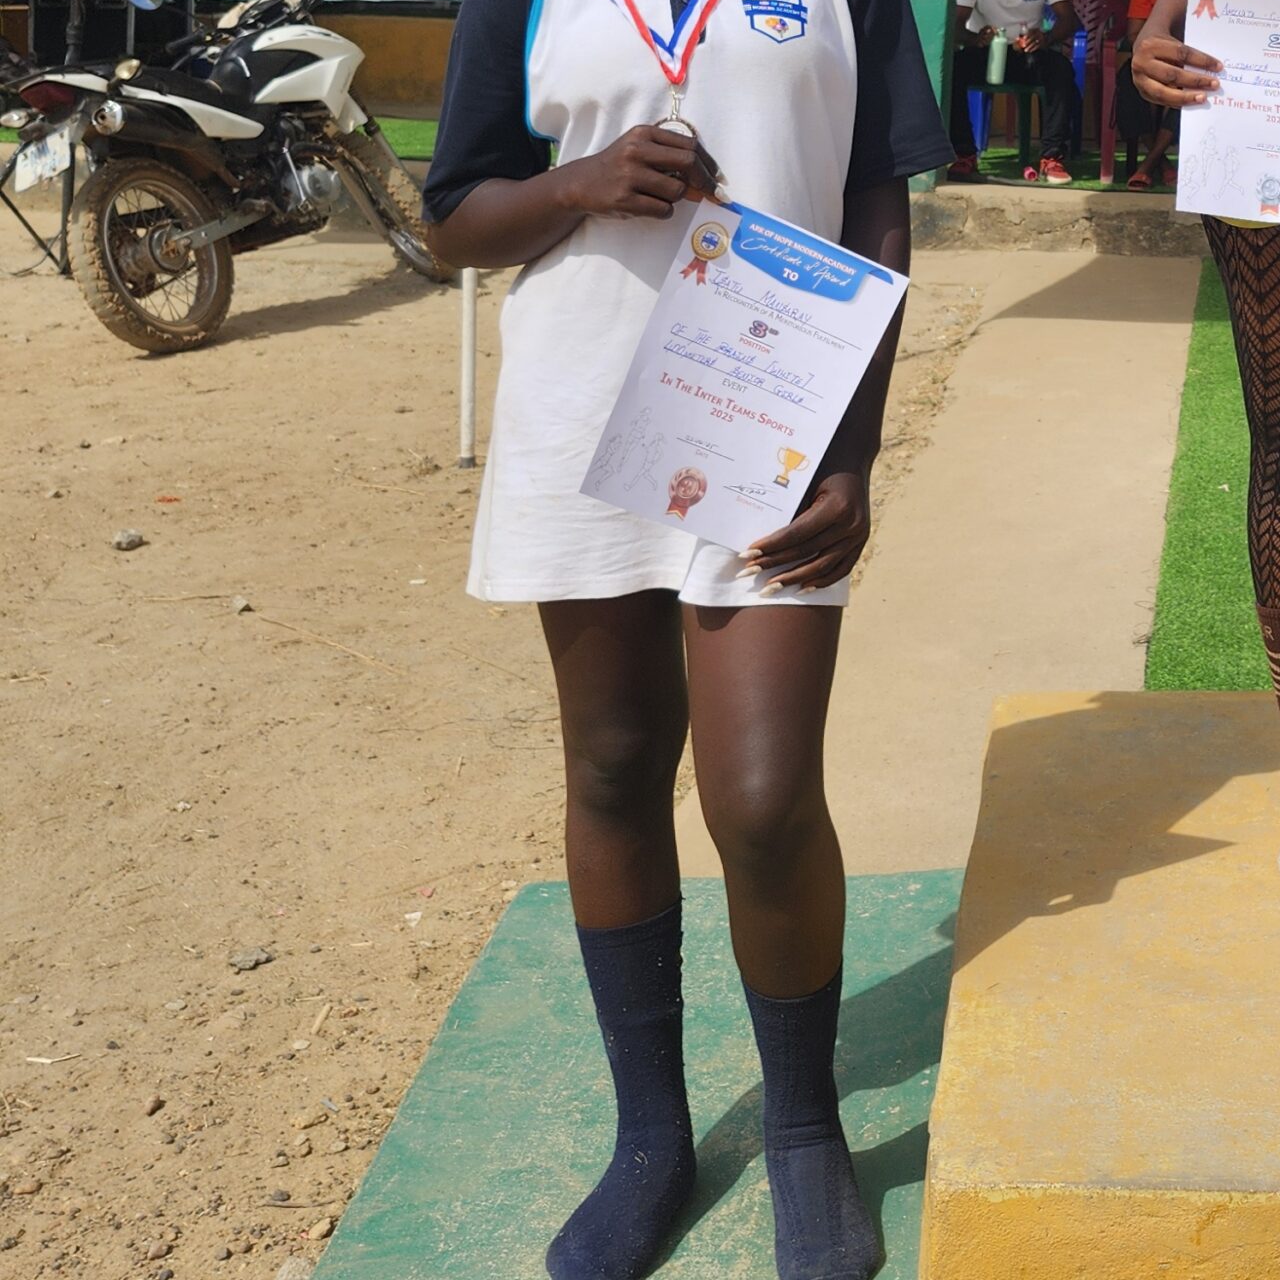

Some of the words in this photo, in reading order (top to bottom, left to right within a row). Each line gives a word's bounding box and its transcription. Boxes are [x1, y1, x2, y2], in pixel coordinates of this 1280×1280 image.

[1227, 98, 1245, 110] THE
[1246, 100, 1273, 113] INTER
[740, 237, 802, 267] Certificate
[749, 223, 765, 235] ARK
[763, 229, 774, 239] OF
[773, 232, 795, 248] HOPE
[793, 242, 825, 263] MODERN
[822, 256, 857, 275] ACADEMY
[783, 268, 799, 281] TO
[740, 336, 771, 354] POSITION
[721, 377, 748, 394] EVENT
[660, 371, 673, 386] IN
[675, 376, 693, 394] THE
[693, 386, 722, 406] INTER
[725, 398, 756, 420] TEAMS
[757, 412, 796, 437] SPORTS
[709, 407, 735, 423] 2025
